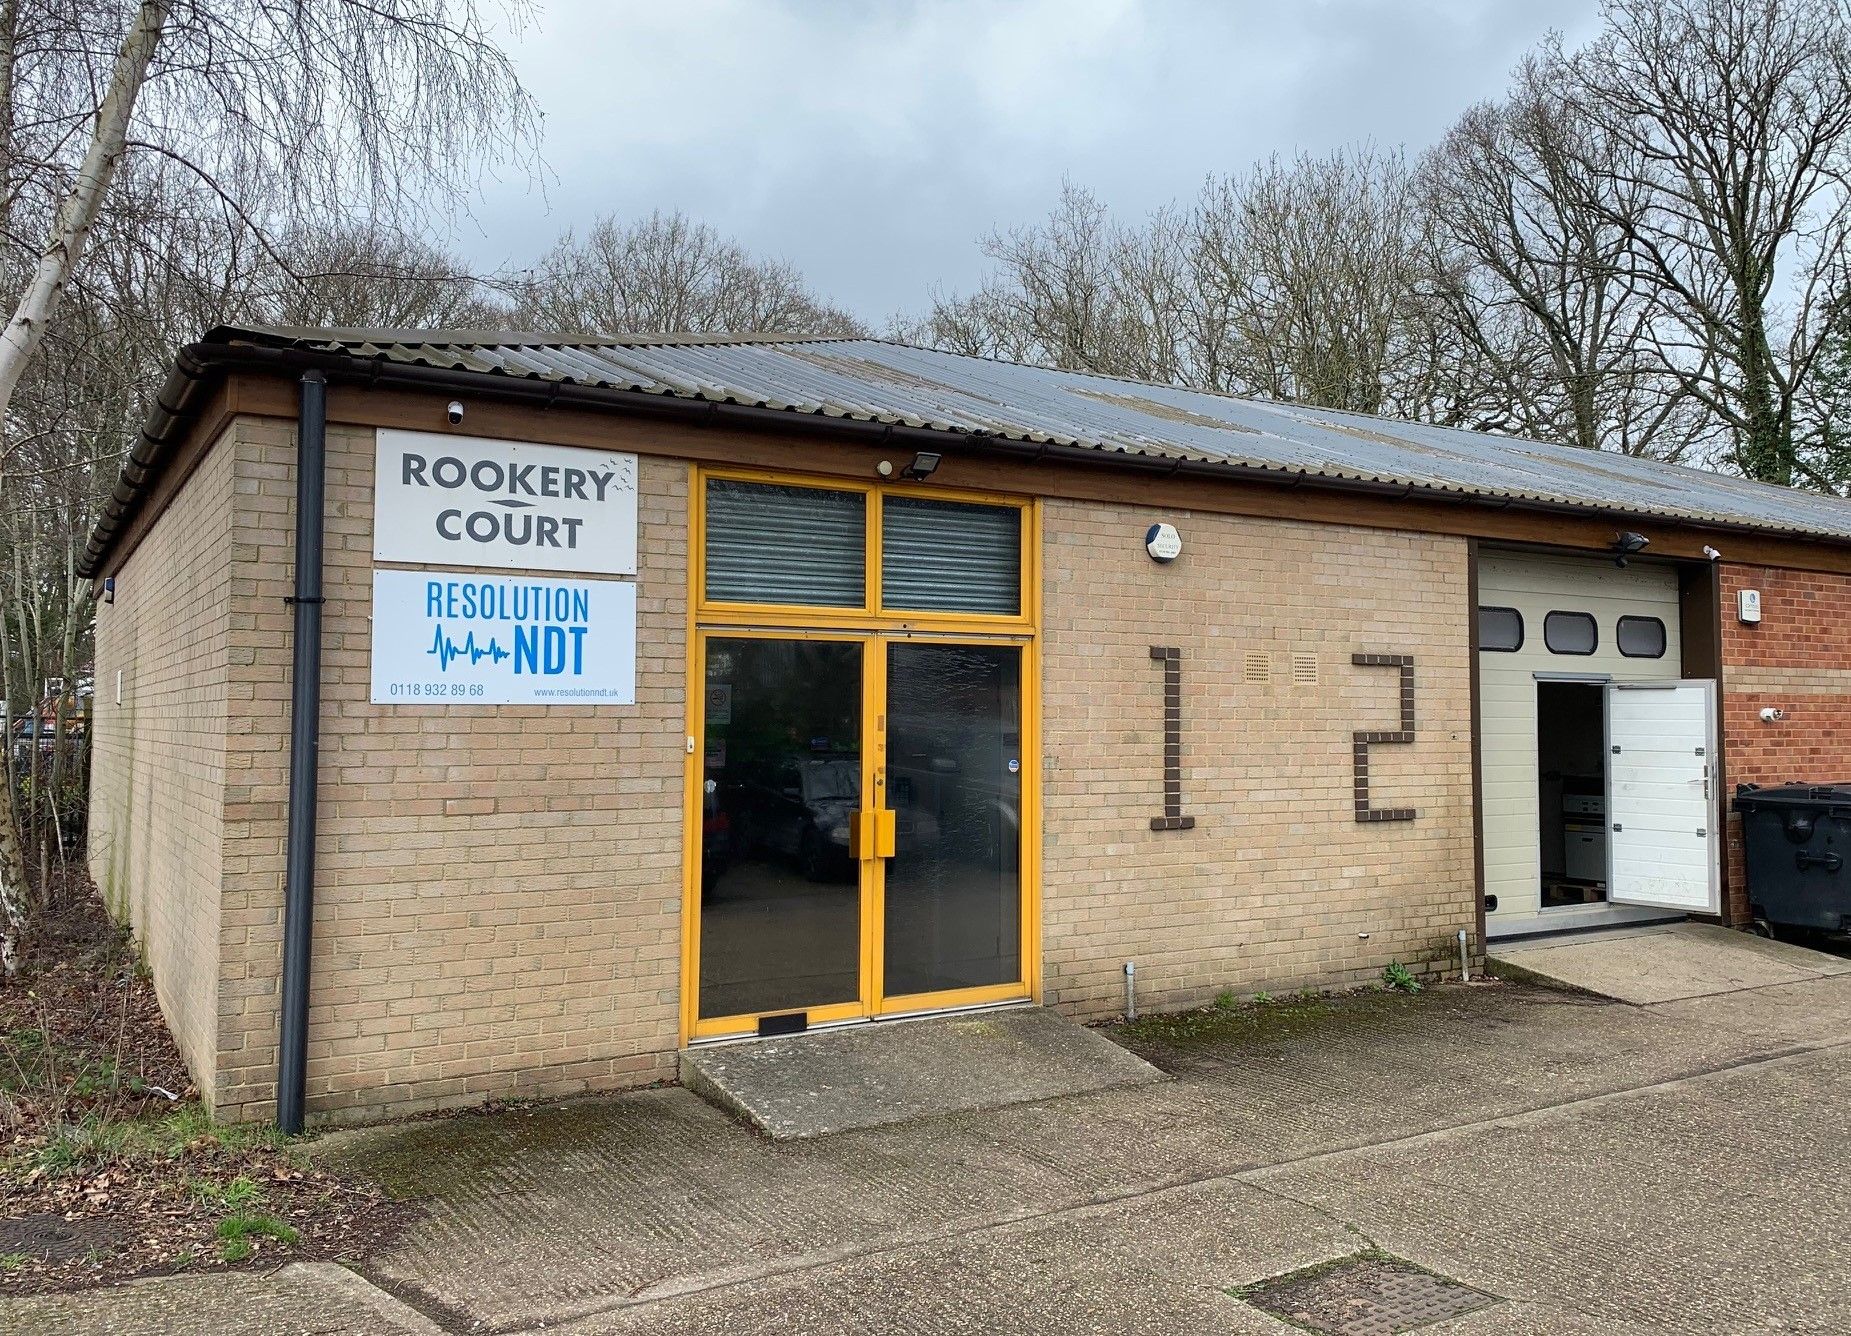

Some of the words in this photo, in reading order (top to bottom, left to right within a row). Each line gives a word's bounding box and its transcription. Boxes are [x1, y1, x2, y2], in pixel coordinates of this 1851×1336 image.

[402, 453, 615, 501] ROOKERY
[436, 509, 583, 549] COURT
[426, 581, 588, 622] RESOLUTION
[514, 625, 588, 675] NDT
[390, 683, 421, 696] 0118
[424, 684, 447, 696] 932
[451, 684, 466, 697] 89
[469, 685, 484, 697] 68
[533, 687, 619, 698] www.resolutionndt.uk
